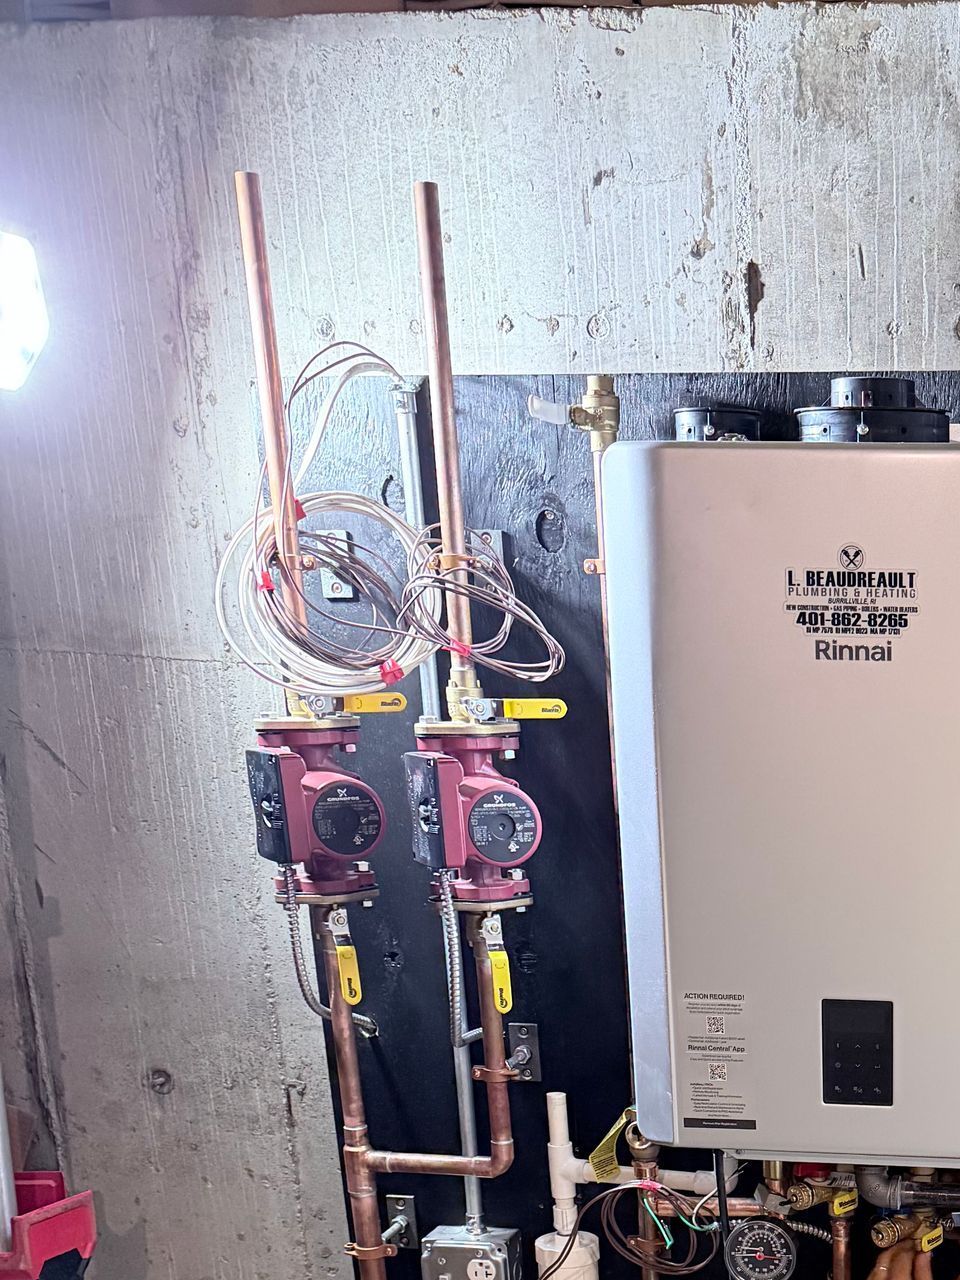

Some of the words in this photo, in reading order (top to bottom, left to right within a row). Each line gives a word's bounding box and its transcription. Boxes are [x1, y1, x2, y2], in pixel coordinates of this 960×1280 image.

[788, 570, 801, 587] L.
[806, 570, 916, 589] BEAUDREAULT
[788, 587, 848, 597] PLUMBING
[854, 588, 861, 597] &
[866, 588, 916, 598] HEATING
[796, 611, 908, 628] 401-862-8265
[815, 639, 893, 662] Rinnai
[684, 992, 709, 1000] ACTION
[709, 993, 745, 1001] REQUIRED!
[732, 1045, 745, 1053] App
